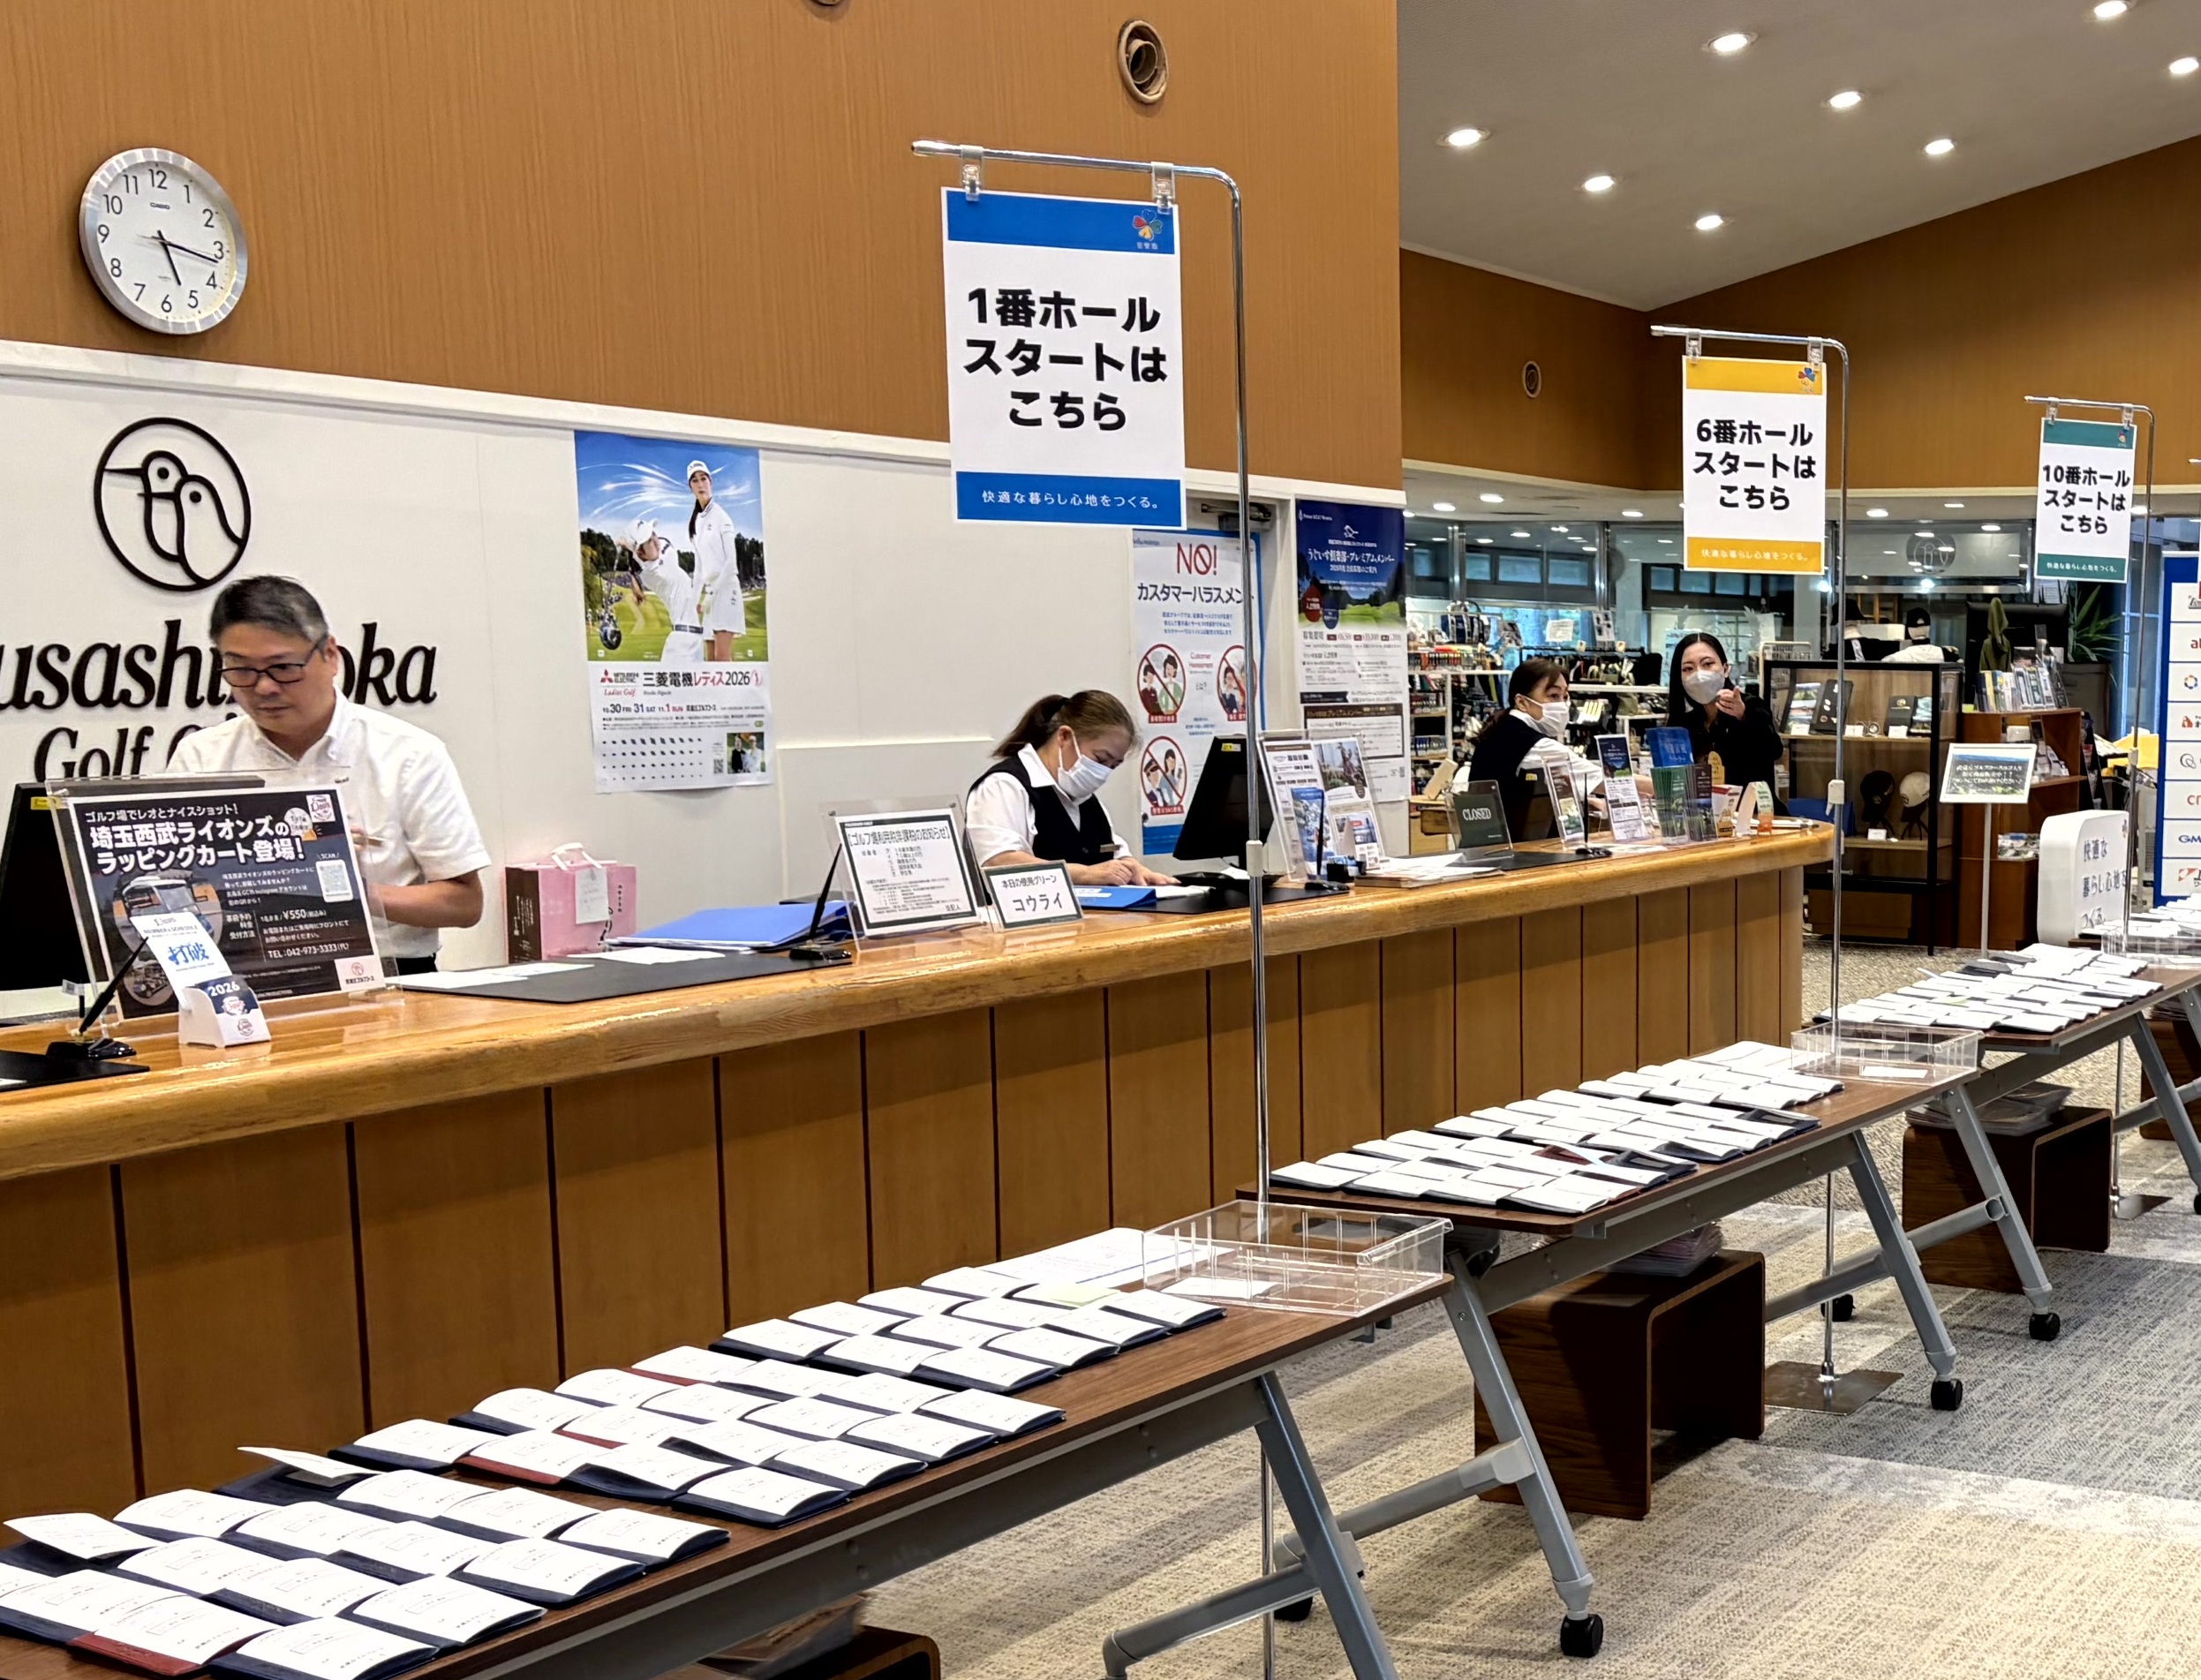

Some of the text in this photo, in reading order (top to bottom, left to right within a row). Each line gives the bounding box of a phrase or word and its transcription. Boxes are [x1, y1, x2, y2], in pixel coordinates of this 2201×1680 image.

[123, 174, 139, 195] 11
[148, 169, 168, 190] 12
[102, 194, 123, 215] 10
[184, 185, 191, 204] 1
[202, 208, 215, 228] 2
[98, 224, 109, 243] 9
[213, 241, 224, 260] 3
[110, 258, 122, 277] 8
[206, 270, 217, 289] 4
[133, 283, 146, 302] 7
[187, 290, 199, 308] 5
[161, 294, 172, 313] 6
[968, 288, 1161, 333] 1番ホール
[963, 338, 1168, 383] スタートは
[1009, 390, 1127, 431] こちら
[1696, 418, 1813, 447] 6番ホール
[1692, 451, 1816, 478] スタートは
[2043, 465, 2130, 487] 10番ホール
[982, 490, 1158, 509] 快適な暮らし心地をつくる。
[1719, 485, 1790, 510] こちら
[2044, 489, 2126, 511] スタートは
[2061, 515, 2107, 534] こちら
[1177, 542, 1217, 576] NO!
[1701, 548, 1807, 561] 快適な暮らし心地をつくる。
[2046, 562, 2117, 573] 快適な暮らし心地をつくる。
[1137, 583, 1255, 604] カスタマーハラスメン
[634, 704, 644, 713] 31
[34, 726, 154, 781] Golf
[1462, 808, 1491, 820] CLOSED
[90, 816, 290, 849] 埼玉西武ライオンズの
[1013, 893, 1062, 911] コウライ
[168, 942, 209, 965] 打破
[207, 982, 240, 997] 2026
